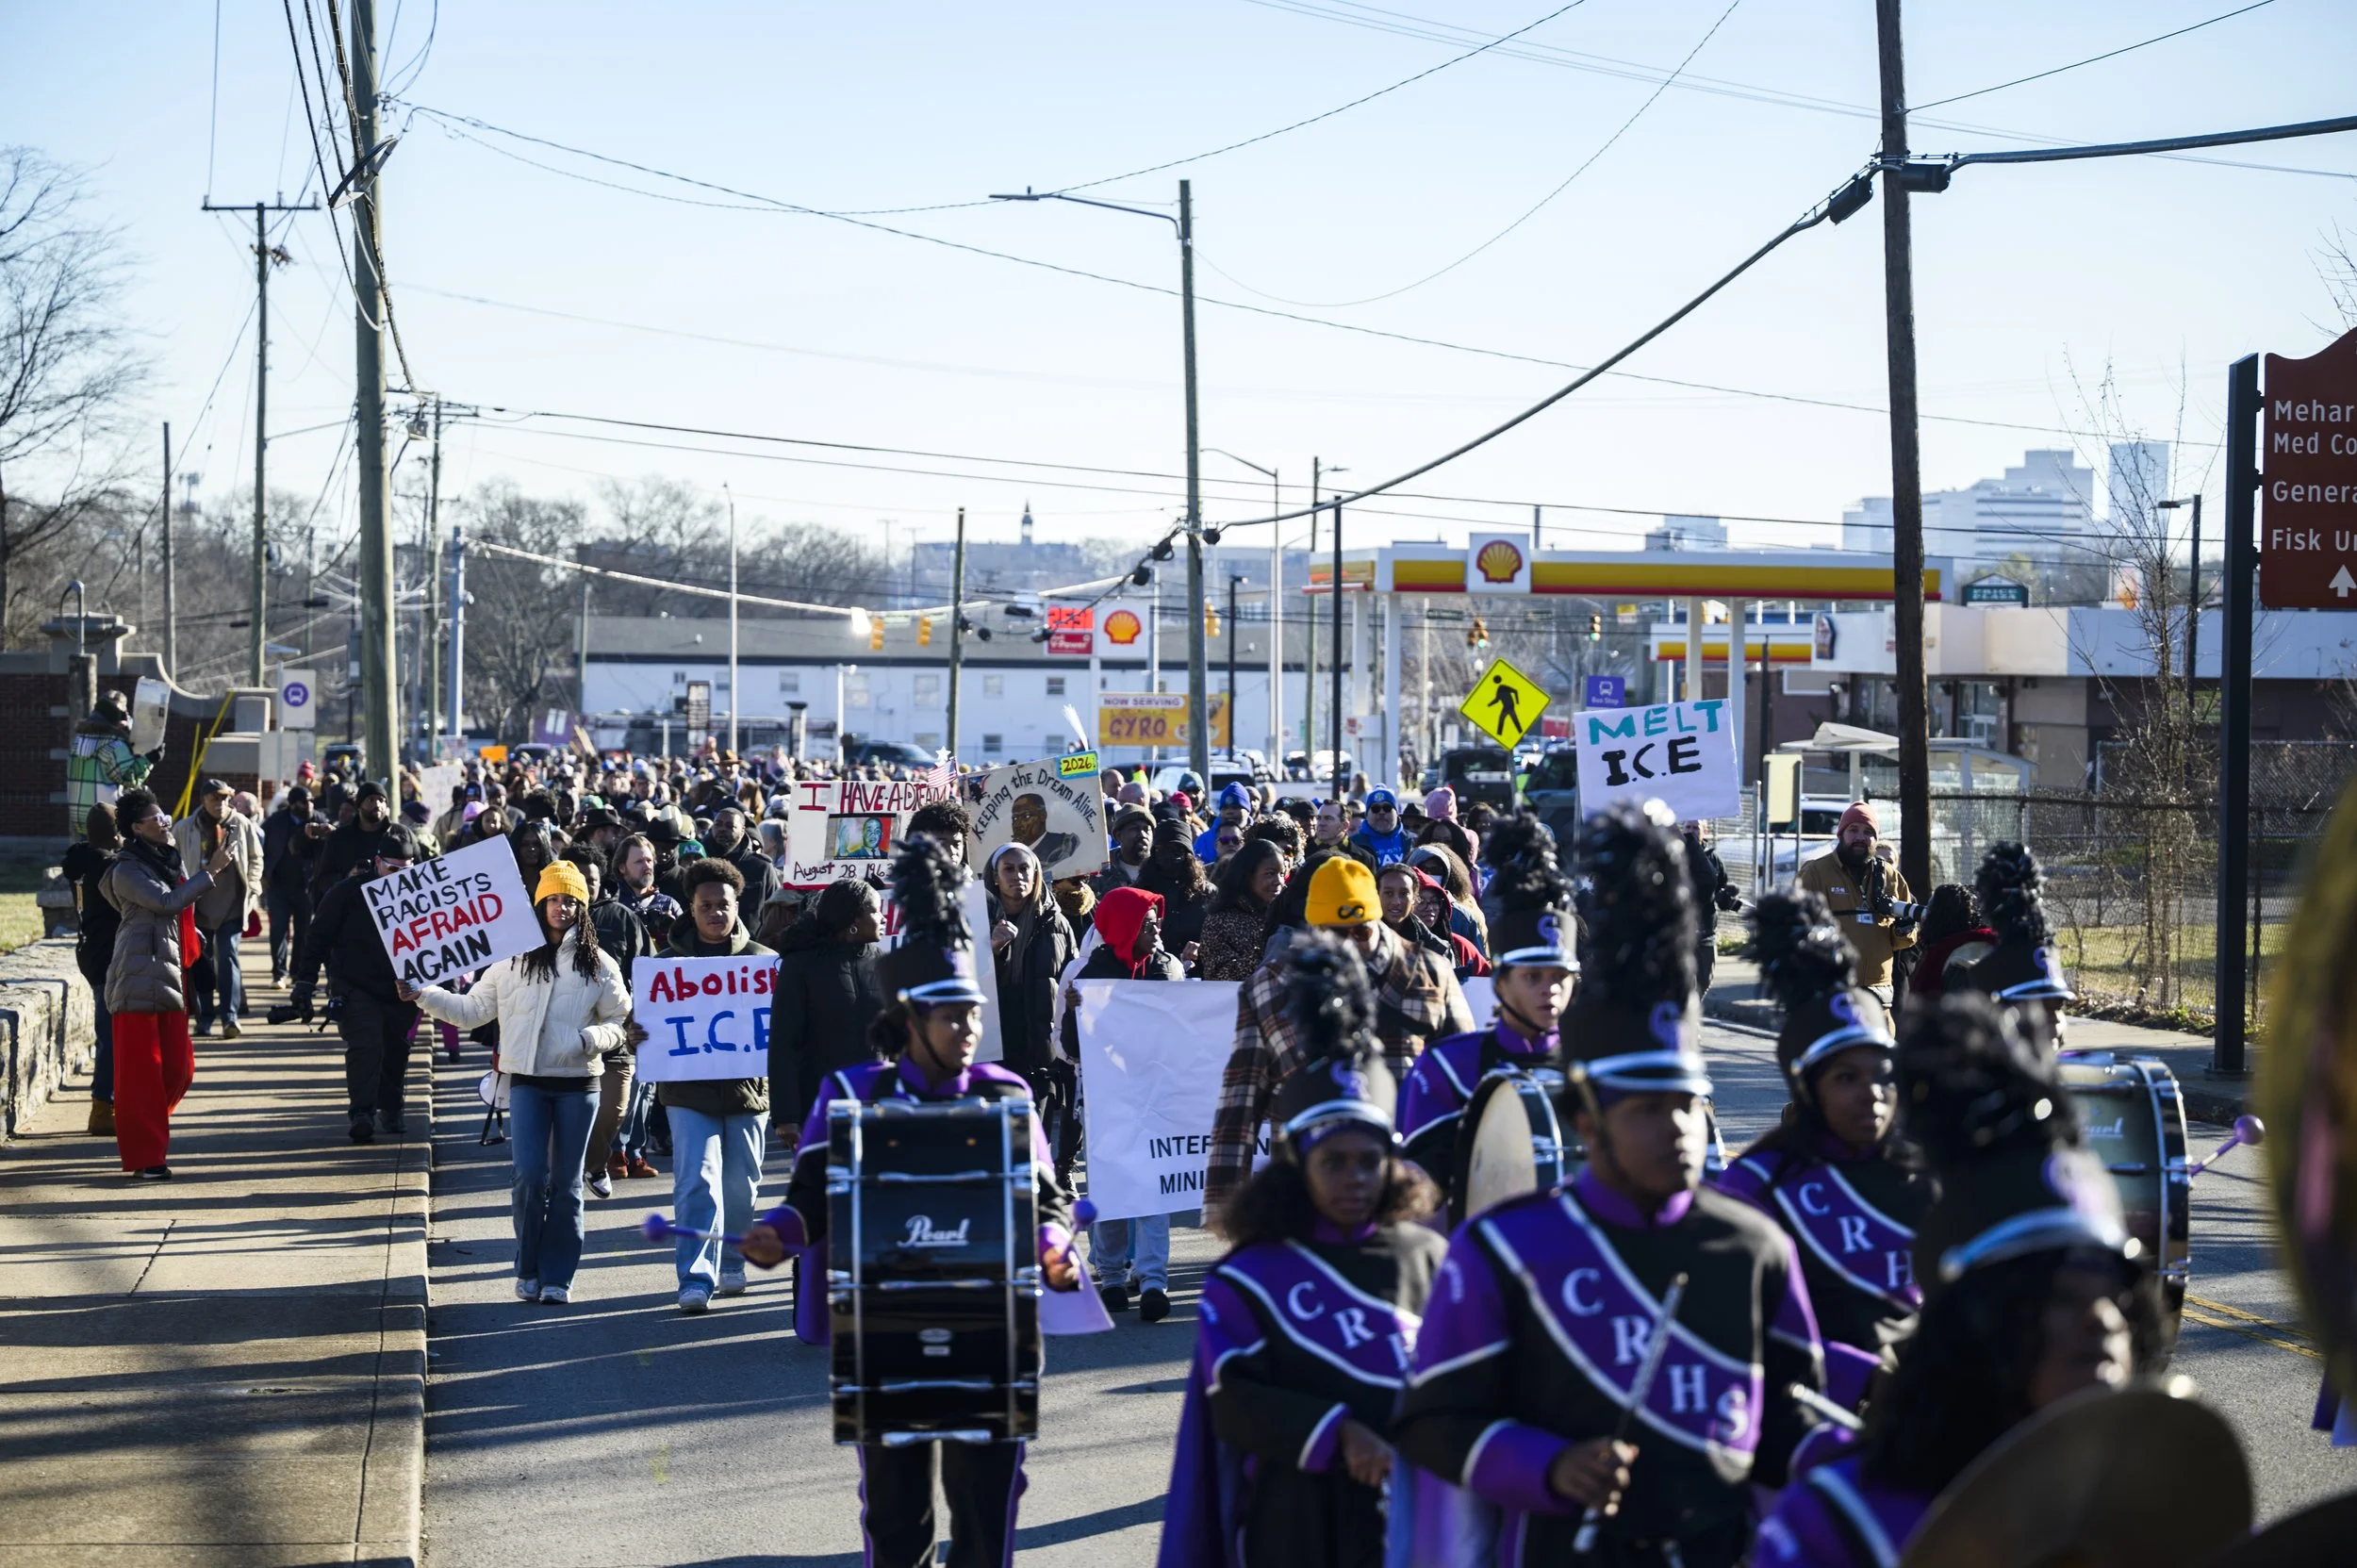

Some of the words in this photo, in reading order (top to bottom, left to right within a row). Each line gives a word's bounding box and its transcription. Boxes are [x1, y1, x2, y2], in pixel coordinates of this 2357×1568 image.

[2274, 400, 2355, 422] Mehar
[2274, 432, 2319, 454] Med
[2272, 528, 2322, 551] Fisk
[2335, 530, 2357, 552] U
[1109, 717, 1167, 740] GYRO
[1589, 701, 1722, 745] MELT
[799, 784, 831, 811] I
[367, 858, 450, 907] MAKE
[794, 862, 834, 881] August
[376, 873, 491, 931] RACISTS
[393, 894, 503, 957] AFRAID
[404, 930, 492, 983] AGAIN
[1160, 1170, 1204, 1195] MINI
[897, 1214, 970, 1247] Pearl
